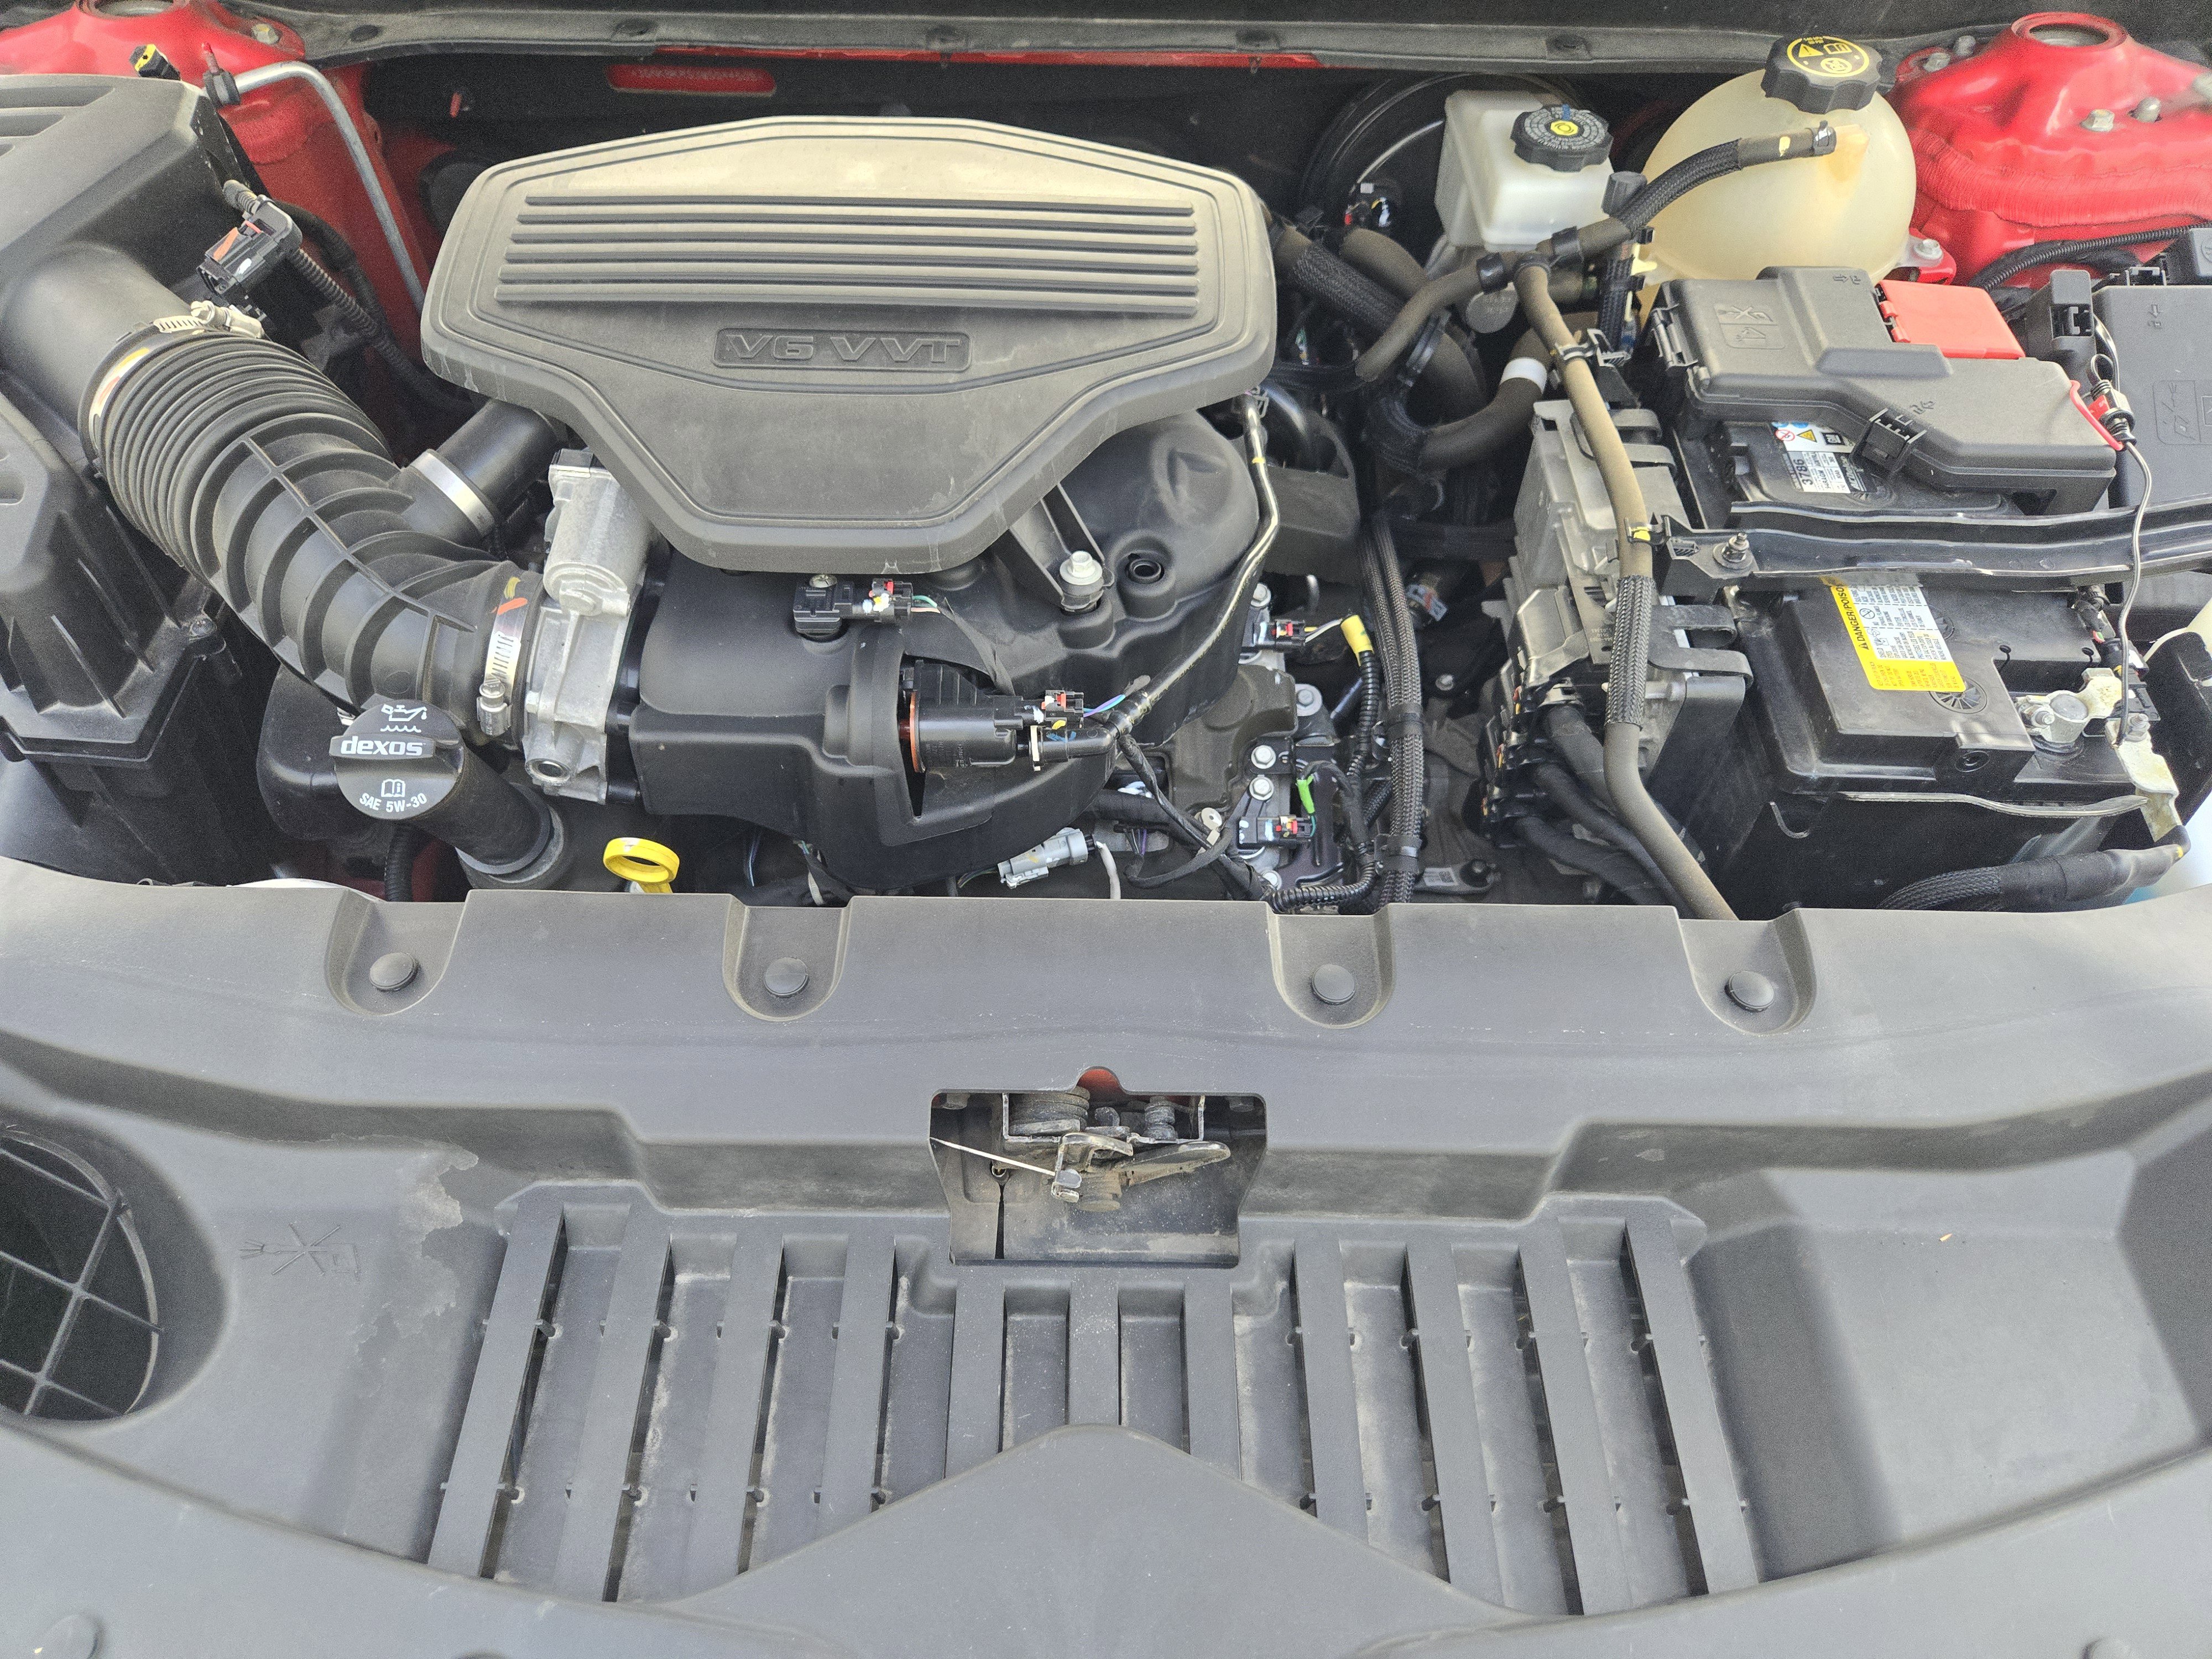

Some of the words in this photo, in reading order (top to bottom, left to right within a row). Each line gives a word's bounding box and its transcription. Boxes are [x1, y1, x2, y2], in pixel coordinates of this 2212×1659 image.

[727, 334, 814, 360] V6
[830, 337, 961, 363] VVT
[1793, 459, 1813, 485] 3786
[1836, 586, 1865, 641] DANGER/POISO
[341, 735, 423, 757] dexos
[359, 792, 382, 811] SAE
[386, 793, 427, 813] 5W-30
